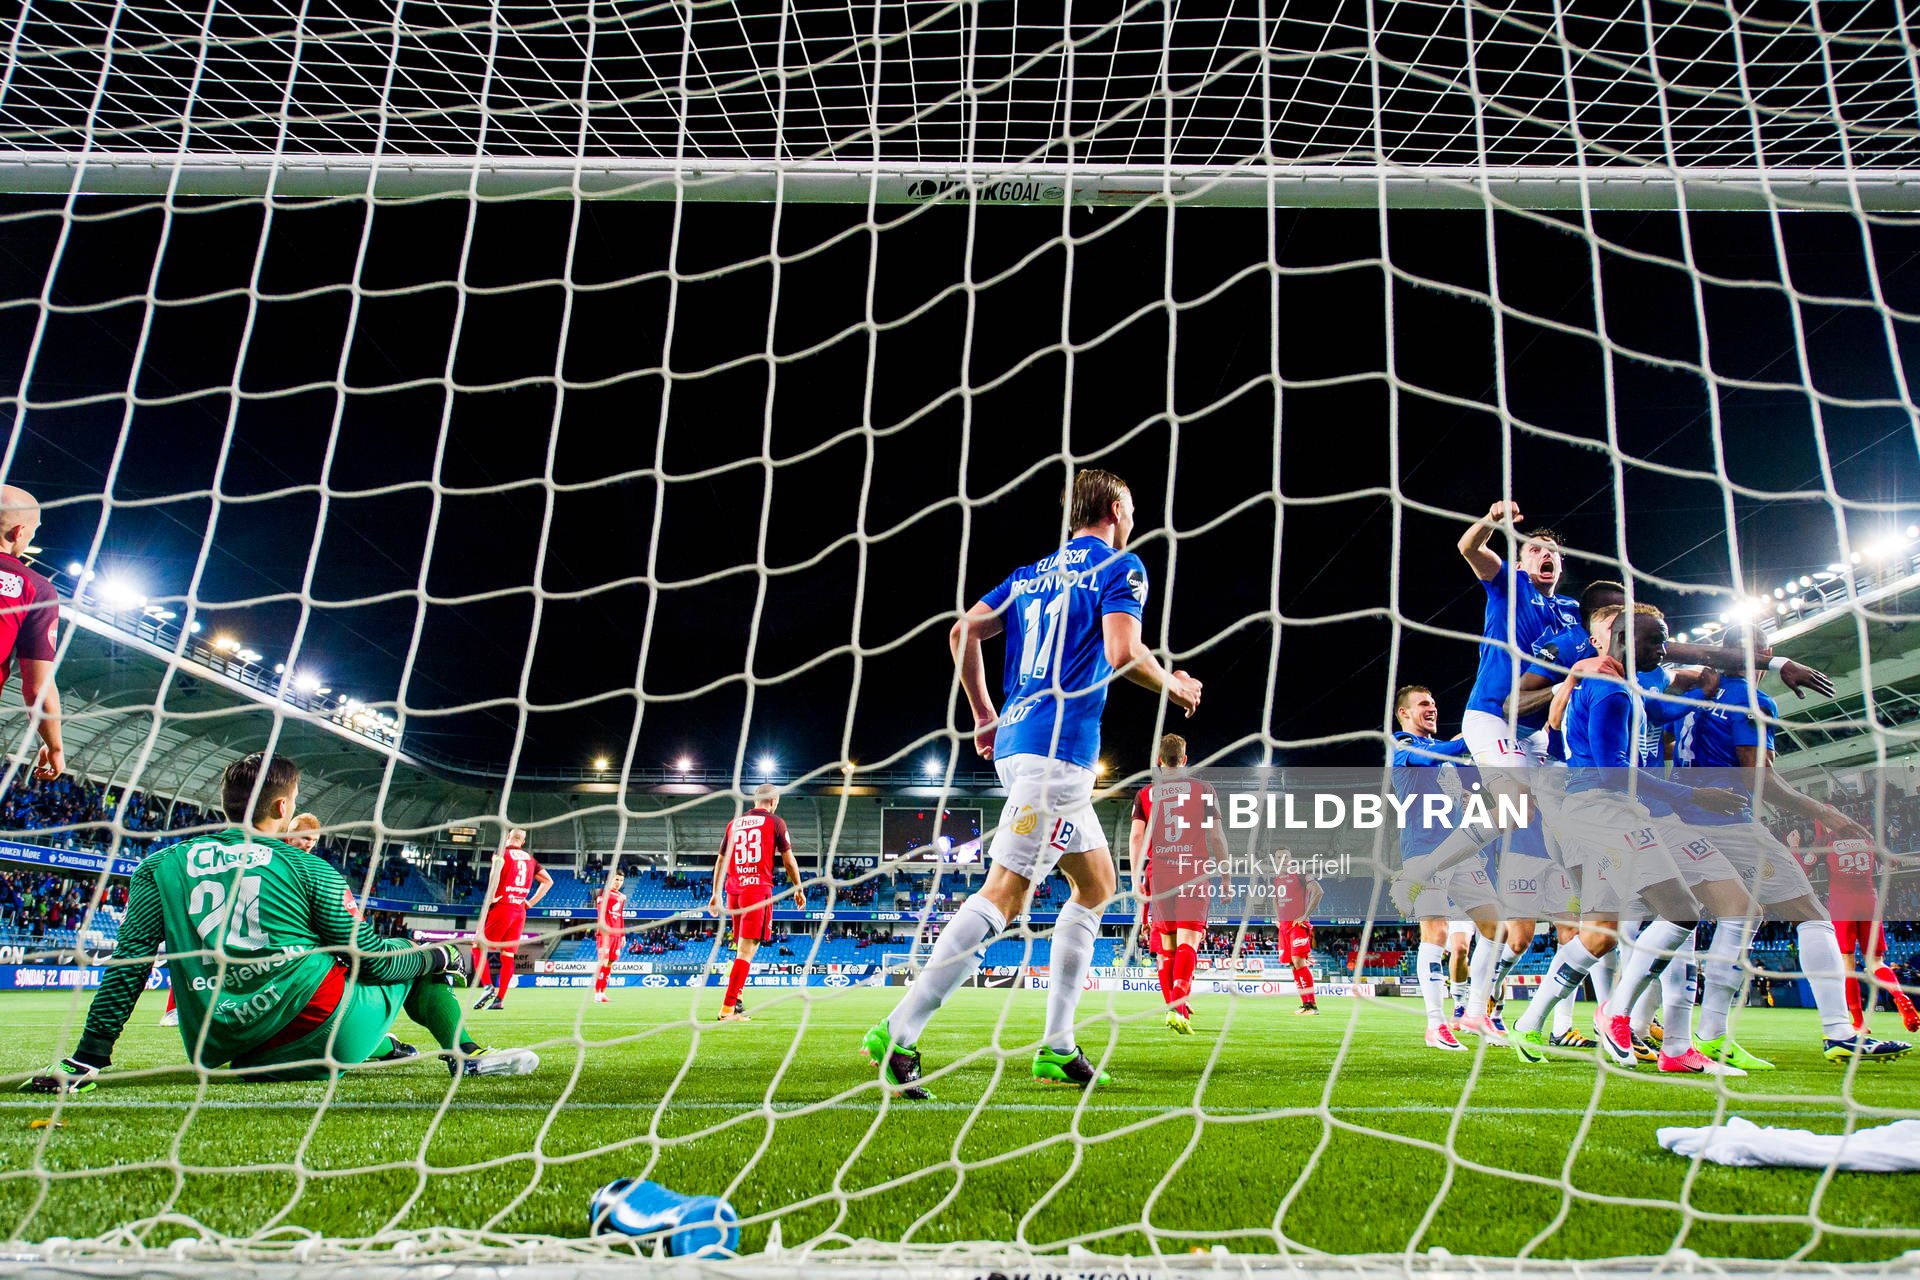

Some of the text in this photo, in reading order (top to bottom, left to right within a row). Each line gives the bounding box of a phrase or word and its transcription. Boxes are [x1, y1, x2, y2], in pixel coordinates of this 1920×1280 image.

[1020, 593, 1064, 686] 11
[734, 828, 762, 865] 33
[838, 857, 874, 868] ISTAD
[514, 860, 527, 887] 3
[417, 903, 439, 912] ISTAD
[549, 909, 572, 917] ISTAD
[555, 963, 587, 971] GLAMOX
[612, 963, 644, 971] GLAMOX
[1262, 982, 1280, 993] Oil
